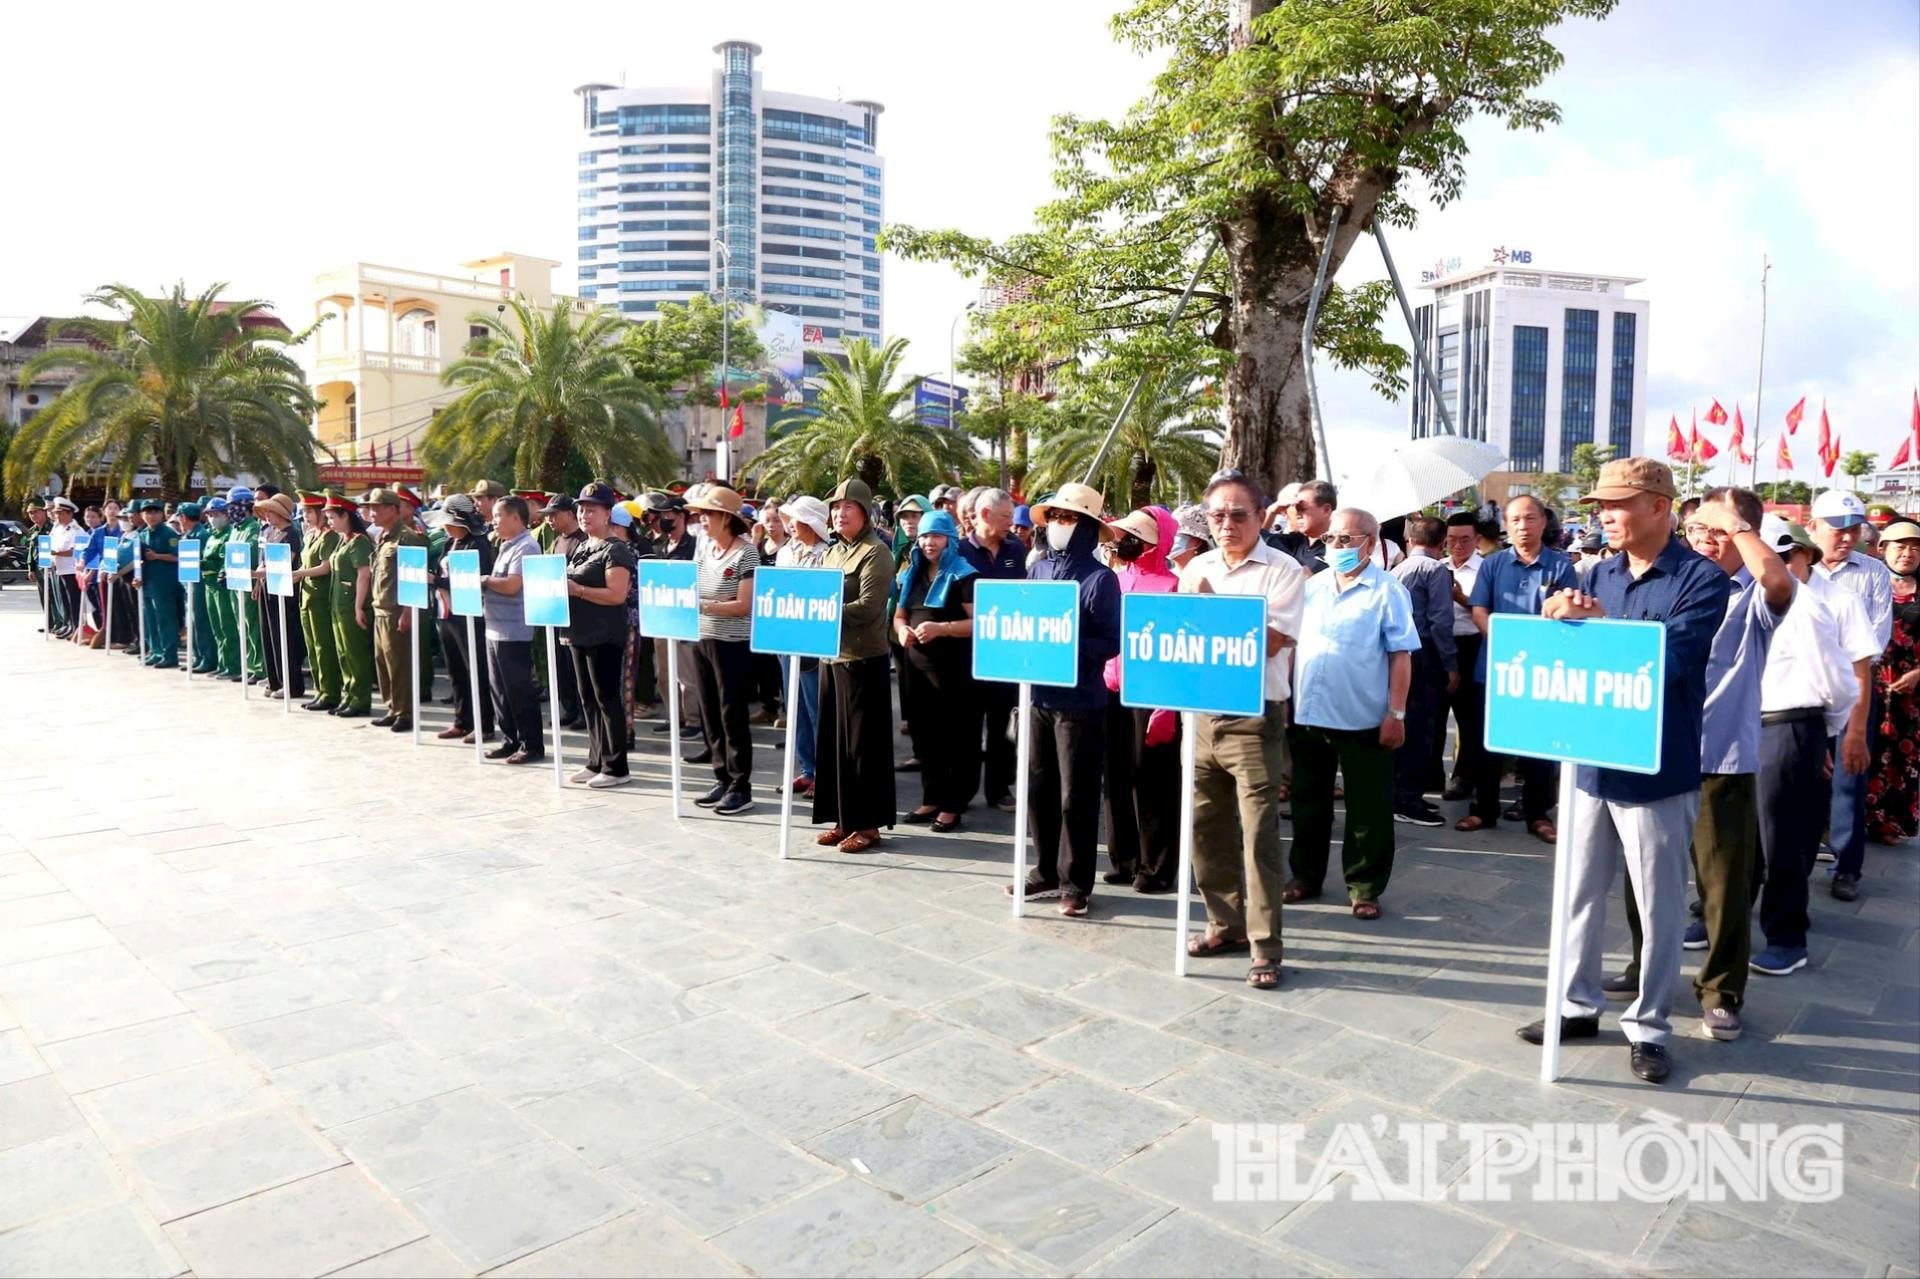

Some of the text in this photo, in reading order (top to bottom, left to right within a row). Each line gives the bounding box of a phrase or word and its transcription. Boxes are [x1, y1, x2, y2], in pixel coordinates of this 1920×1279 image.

[1511, 250, 1532, 263] MB
[757, 588, 838, 622] TỔ DÂN PHỐ
[978, 605, 1073, 644] TỔ DÂN PHỐ
[1128, 621, 1259, 668] TỔ DÂN PHỐ
[1494, 650, 1654, 711] TỔ DÂN PHỐ
